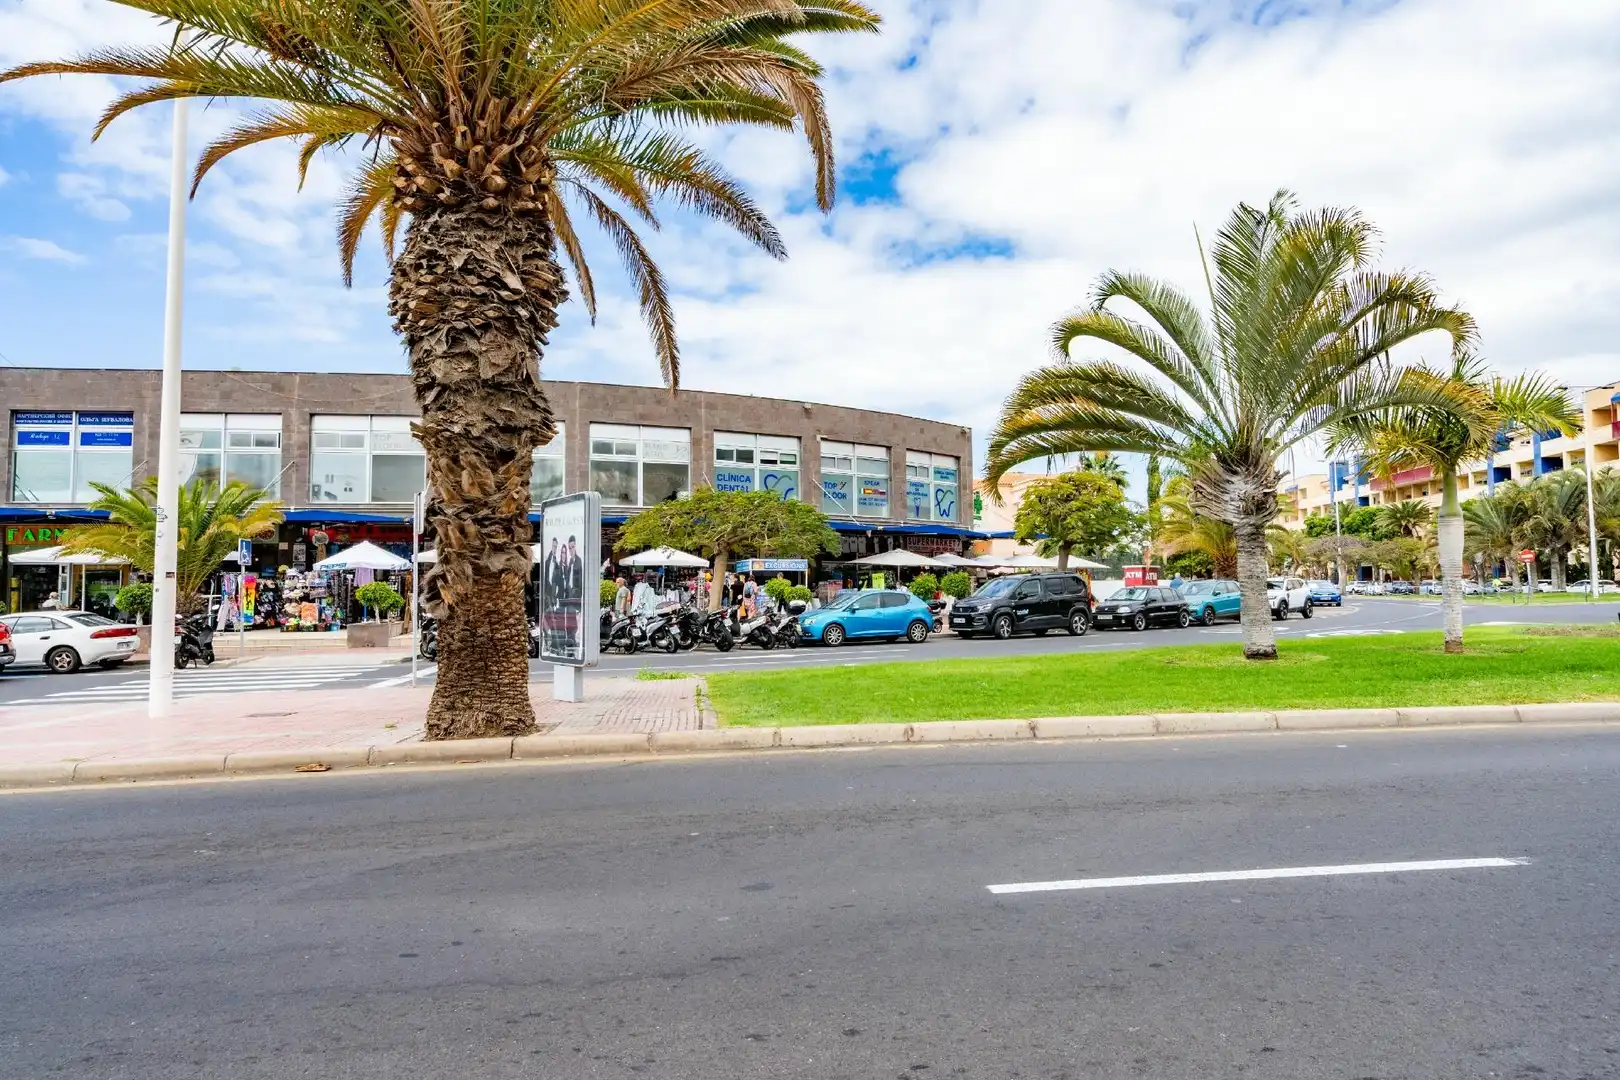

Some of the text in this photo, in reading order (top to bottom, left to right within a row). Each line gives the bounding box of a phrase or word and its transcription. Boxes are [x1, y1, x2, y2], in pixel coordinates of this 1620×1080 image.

[823, 481, 838, 489] TOP
[1126, 571, 1142, 579] ATM
[1145, 572, 1158, 581] ATM
